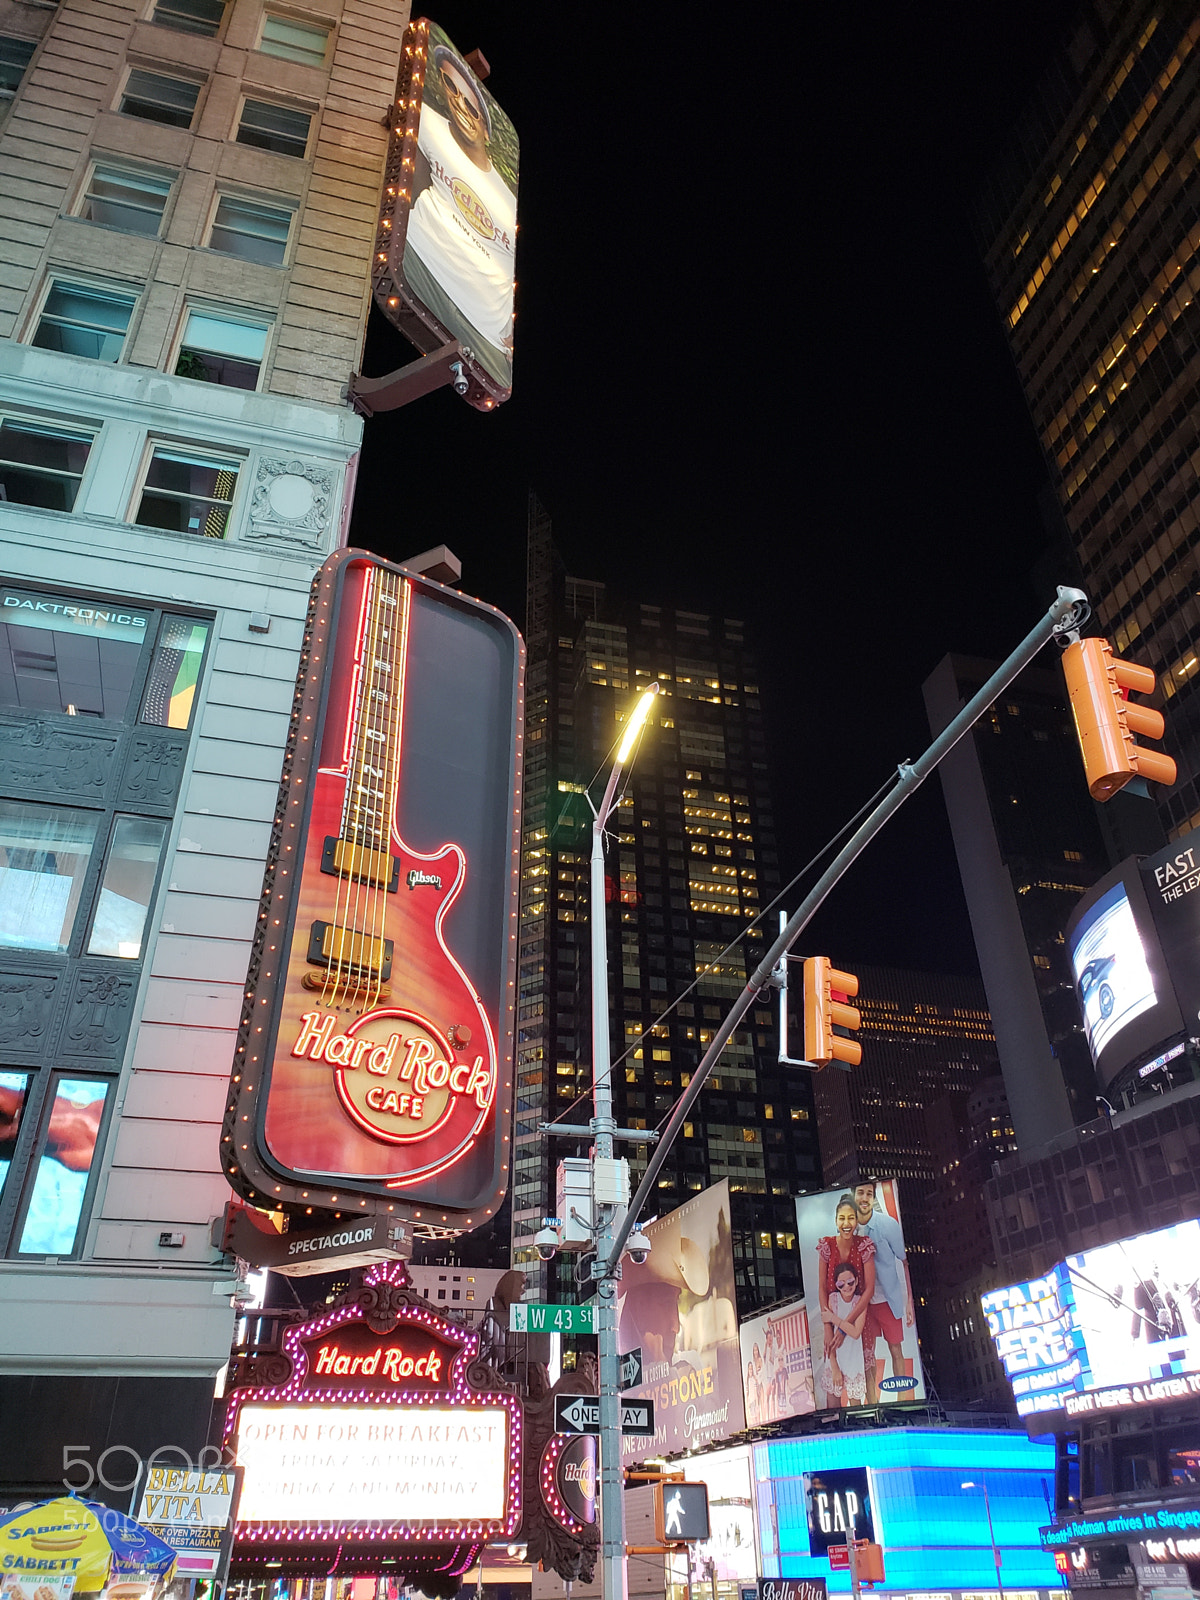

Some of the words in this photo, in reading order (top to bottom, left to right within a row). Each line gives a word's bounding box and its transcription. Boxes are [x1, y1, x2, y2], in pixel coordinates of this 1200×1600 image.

[434, 160, 472, 207] Hard
[474, 202, 511, 250] Rock
[472, 237, 491, 259] YORK
[3, 596, 147, 627] DAKTRONICS
[1154, 847, 1195, 887] FAST
[409, 870, 442, 888] Gibson
[1161, 885, 1183, 904] THE
[291, 1012, 401, 1075] Hard
[399, 1037, 493, 1108] Rock
[366, 1087, 425, 1120] CAFE
[544, 1218, 561, 1226] NYPD
[647, 1216, 675, 1238] LEVISION
[288, 1227, 373, 1255] SPECTACOLOR
[531, 1308, 545, 1329] W
[554, 1309, 573, 1330] 43
[580, 1309, 592, 1323] St
[315, 1346, 382, 1375] Hard
[382, 1347, 441, 1382] Rock
[623, 1360, 636, 1382] WAY
[650, 1362, 670, 1383] COSTNER
[882, 1379, 896, 1389] OLD
[896, 1378, 914, 1388] NAVY
[1095, 1388, 1131, 1407] HERE
[1133, 1387, 1143, 1402] &
[1143, 1376, 1187, 1400] LISTEN
[571, 1407, 599, 1422] ONE
[622, 1409, 642, 1424] AY
[684, 1400, 729, 1439] Paramount
[245, 1424, 309, 1442] OPEN
[317, 1424, 359, 1442] FOR
[367, 1424, 497, 1442] BREAKFAST
[147, 1468, 230, 1495] BELLA
[144, 1494, 204, 1521] VITA
[817, 1490, 859, 1533] GAP
[7, 1522, 90, 1540] SABRETT
[166, 1528, 189, 1538] OVEN
[189, 1529, 212, 1538] PIZZA
[213, 1530, 220, 1539] &
[1072, 1519, 1106, 1537] Rodman
[1107, 1514, 1144, 1533] arrives
[1144, 1512, 1157, 1528] in
[170, 1537, 221, 1547] RESTAURANT
[2, 1554, 81, 1571] SABRETT
[763, 1581, 795, 1600] Bella
[797, 1581, 823, 1600] Vita
